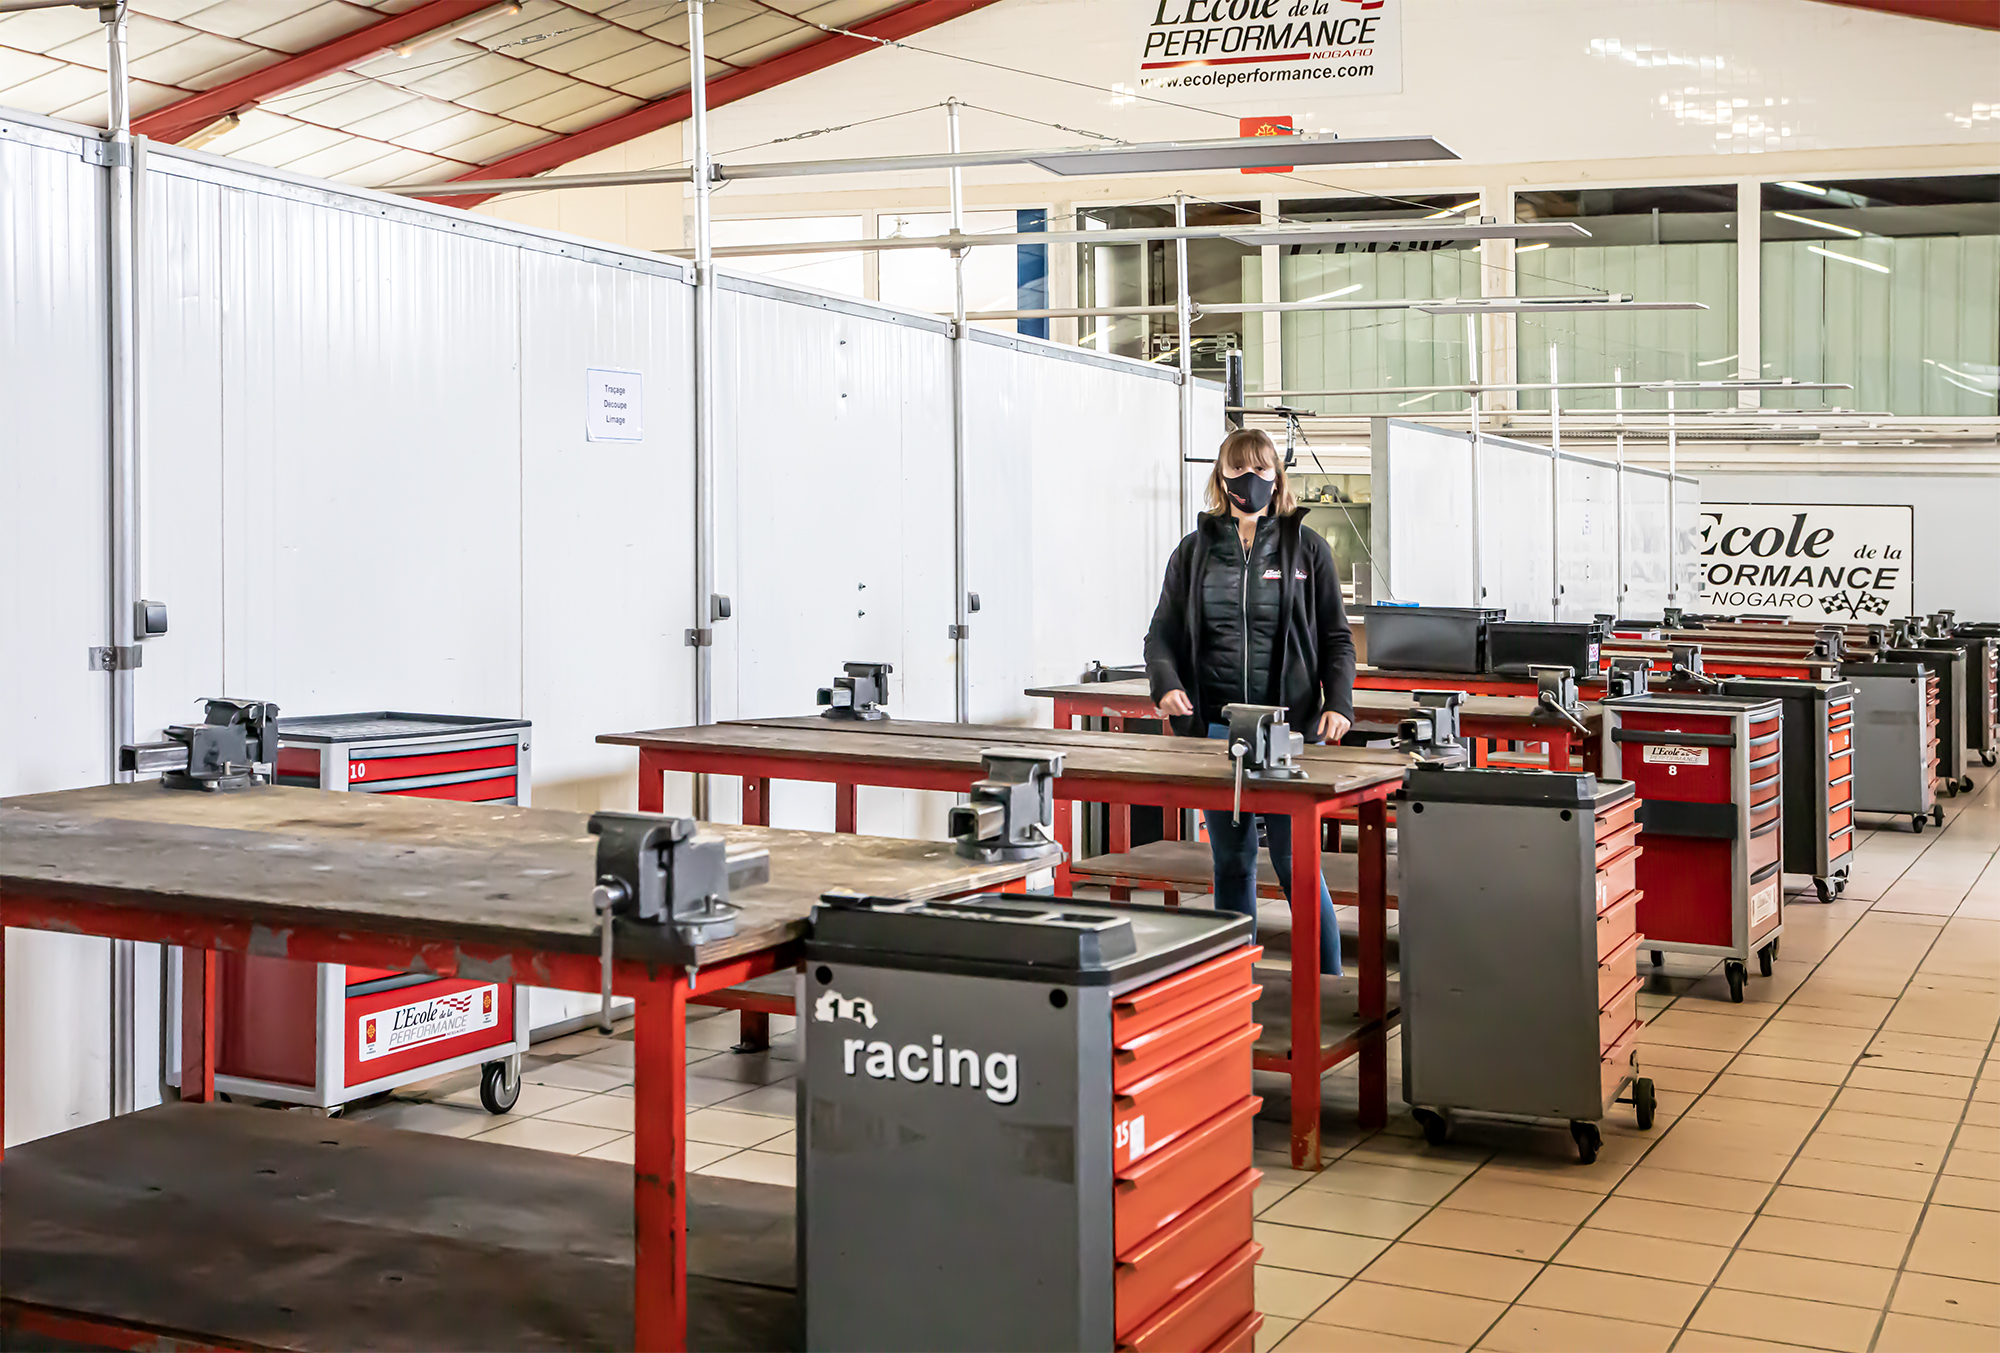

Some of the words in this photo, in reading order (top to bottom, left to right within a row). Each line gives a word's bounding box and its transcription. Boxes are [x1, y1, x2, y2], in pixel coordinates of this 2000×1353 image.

[1150, 0, 1279, 27] LEcole
[1288, 0, 1309, 17] de
[1311, 0, 1329, 15] la
[1143, 17, 1381, 58] PERFORMANCE
[1312, 48, 1373, 60] NOGARO
[604, 384, 626, 396] Traçage
[605, 414, 626, 426] Limage
[1853, 545, 1877, 560] de
[1883, 545, 1902, 560] la
[1701, 563, 1900, 590] ORMANCE
[1712, 591, 1814, 608] NOGARO
[350, 762, 366, 779] 10
[1668, 765, 1677, 776] 8
[392, 1002, 438, 1031] L'Ecole
[447, 1008, 453, 1018] la
[389, 1014, 469, 1046] PERFORMANCE
[843, 1034, 1019, 1105] racing
[1115, 1120, 1129, 1149] 15
